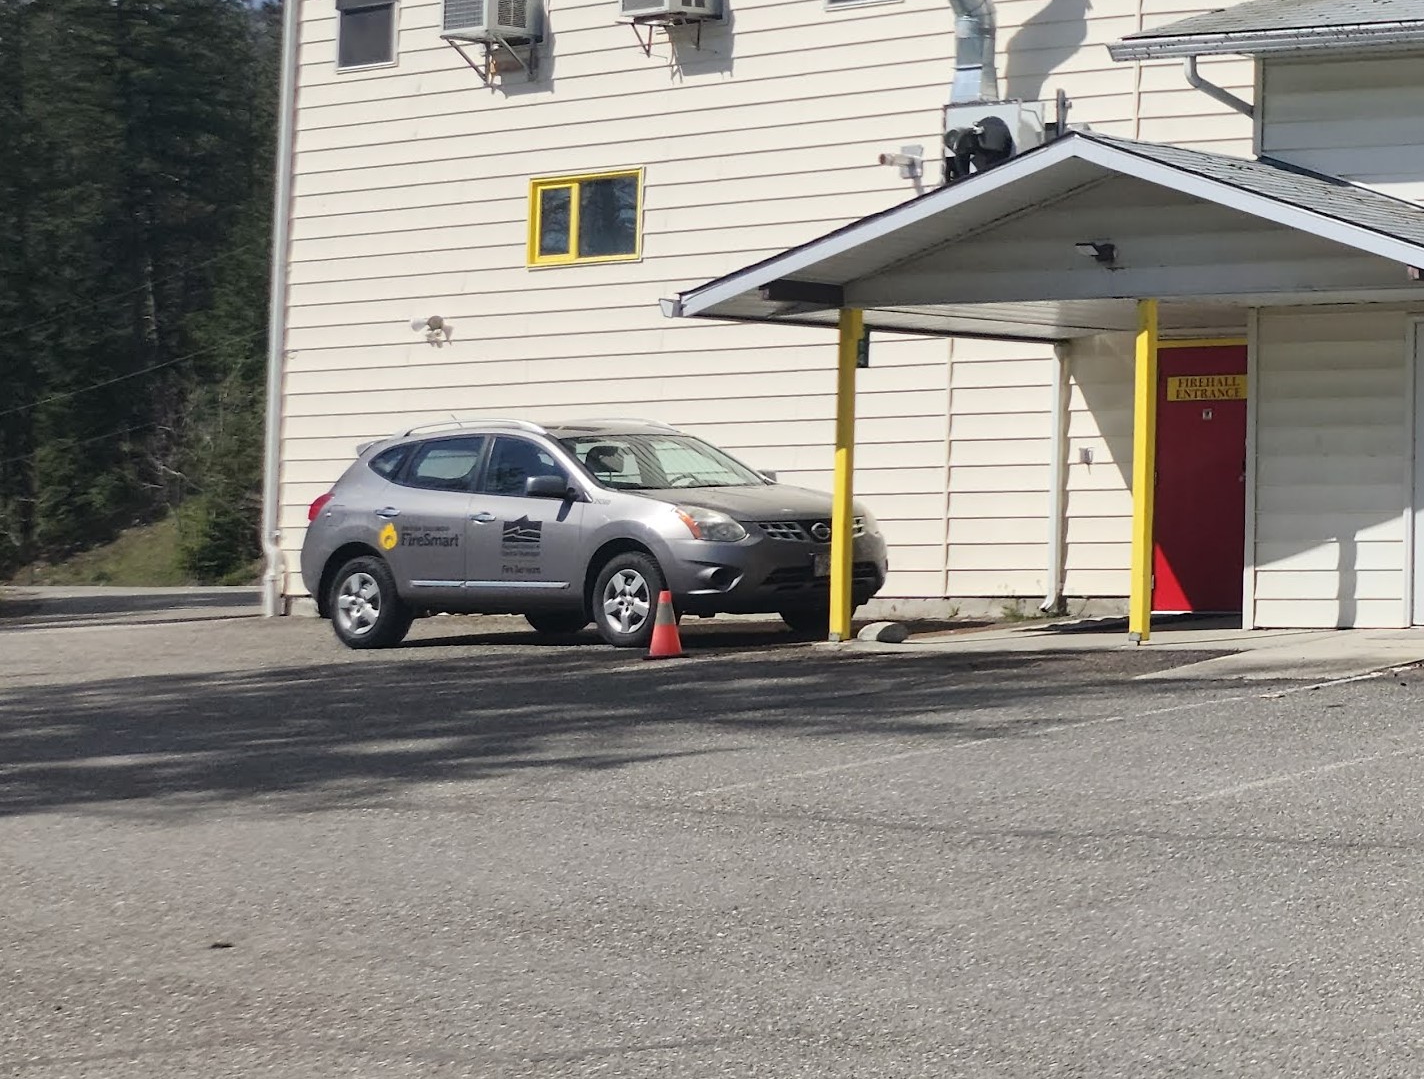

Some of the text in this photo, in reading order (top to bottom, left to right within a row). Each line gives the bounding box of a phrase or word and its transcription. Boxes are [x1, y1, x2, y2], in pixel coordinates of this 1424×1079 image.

[1177, 376, 1240, 388] FIREHALL
[1175, 387, 1241, 400] ENTRANCE
[401, 532, 459, 547] FireSmart
